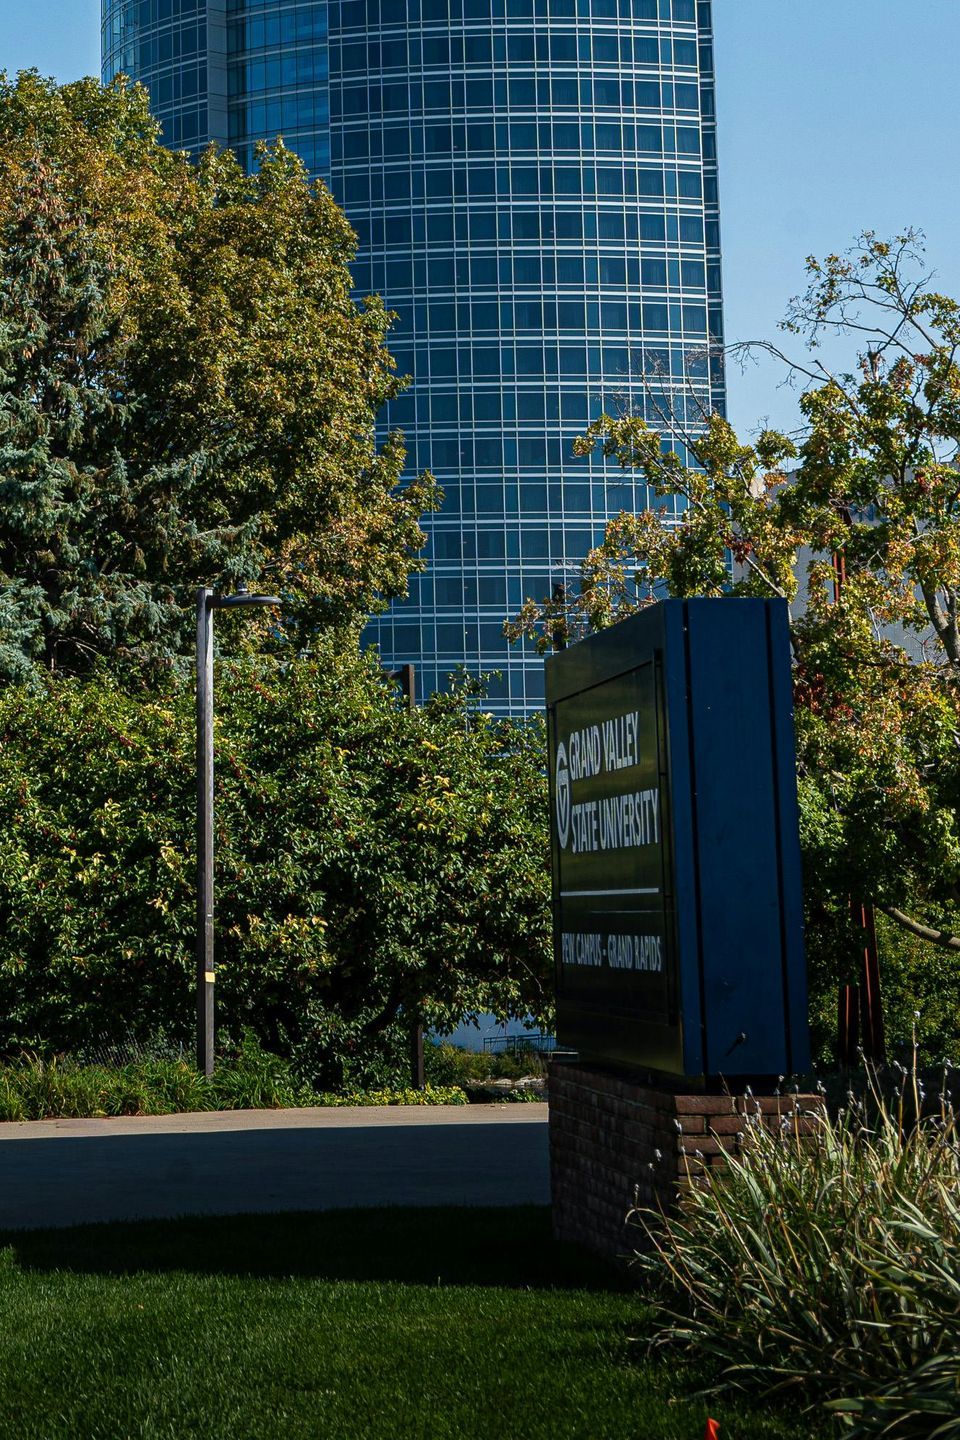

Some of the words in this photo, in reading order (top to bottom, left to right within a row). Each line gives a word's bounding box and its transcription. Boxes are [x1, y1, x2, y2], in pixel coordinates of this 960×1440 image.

[569, 725, 601, 781] GRAND
[602, 711, 639, 772] VALLEY
[571, 801, 599, 854] STATE
[599, 788, 659, 850] UNIVERSITY
[561, 932, 575, 964] PEW
[576, 933, 602, 967] CAMPUS
[607, 934, 633, 969] GRAND
[634, 935, 662, 972] RAPIDS
